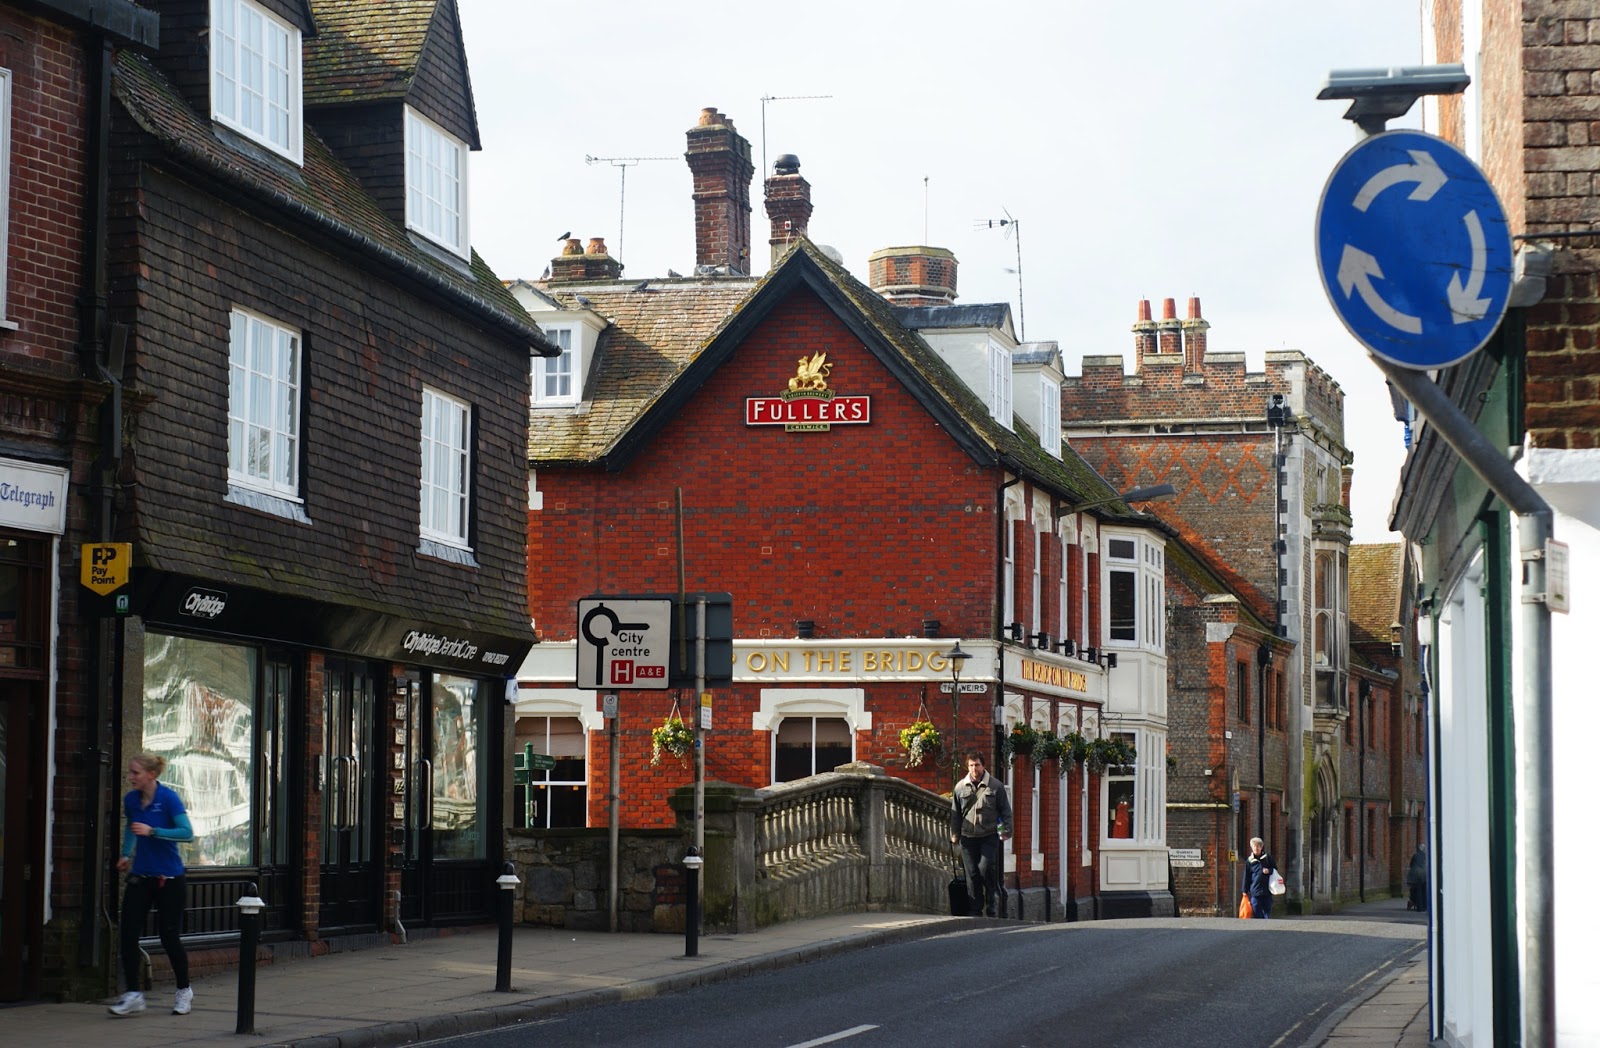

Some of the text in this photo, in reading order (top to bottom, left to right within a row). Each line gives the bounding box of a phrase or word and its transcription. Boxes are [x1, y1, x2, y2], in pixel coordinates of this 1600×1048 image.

[754, 399, 862, 420] FULLER'S
[0, 482, 55, 510] Telegraph
[91, 567, 108, 577] Pay
[91, 576, 116, 585] Point
[619, 632, 644, 645] City
[611, 646, 650, 657] centre
[746, 651, 790, 673] ON
[802, 651, 851, 672] THE
[863, 651, 952, 672] BRIDG
[614, 662, 630, 682] H
[943, 684, 985, 692] TH WEIRS
